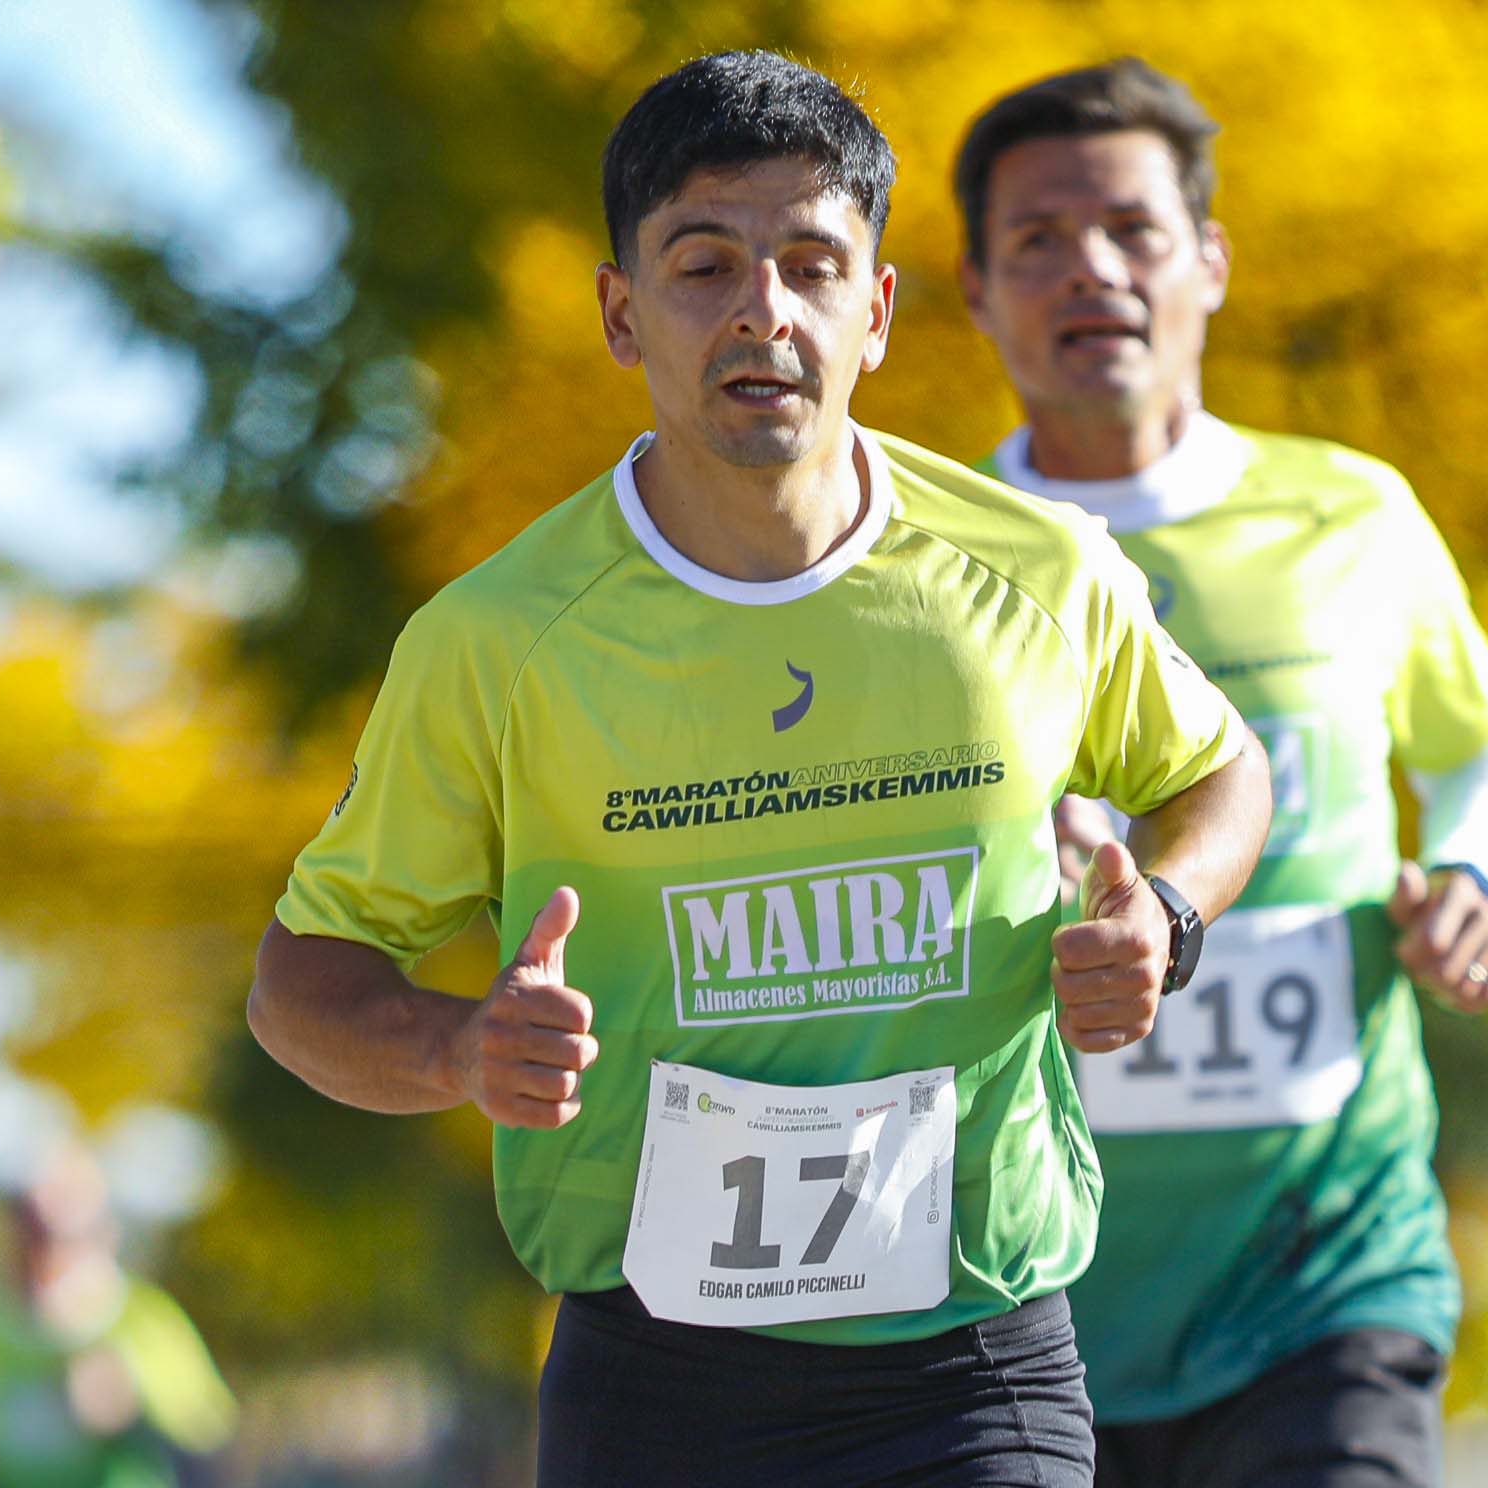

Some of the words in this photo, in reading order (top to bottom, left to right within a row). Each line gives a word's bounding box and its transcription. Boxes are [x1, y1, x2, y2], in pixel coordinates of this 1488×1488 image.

[602, 761, 1005, 833] CAWILLIAMSKEMMIS
[682, 865, 954, 981] MAIRA
[693, 982, 807, 1014] Almacenes
[812, 971, 920, 1005] Mayoristas
[710, 1150, 872, 1270] 17
[699, 1279, 743, 1299] EDGAR
[746, 1278, 794, 1299] CAMILO
[797, 1272, 866, 1295] PICCINELLI
